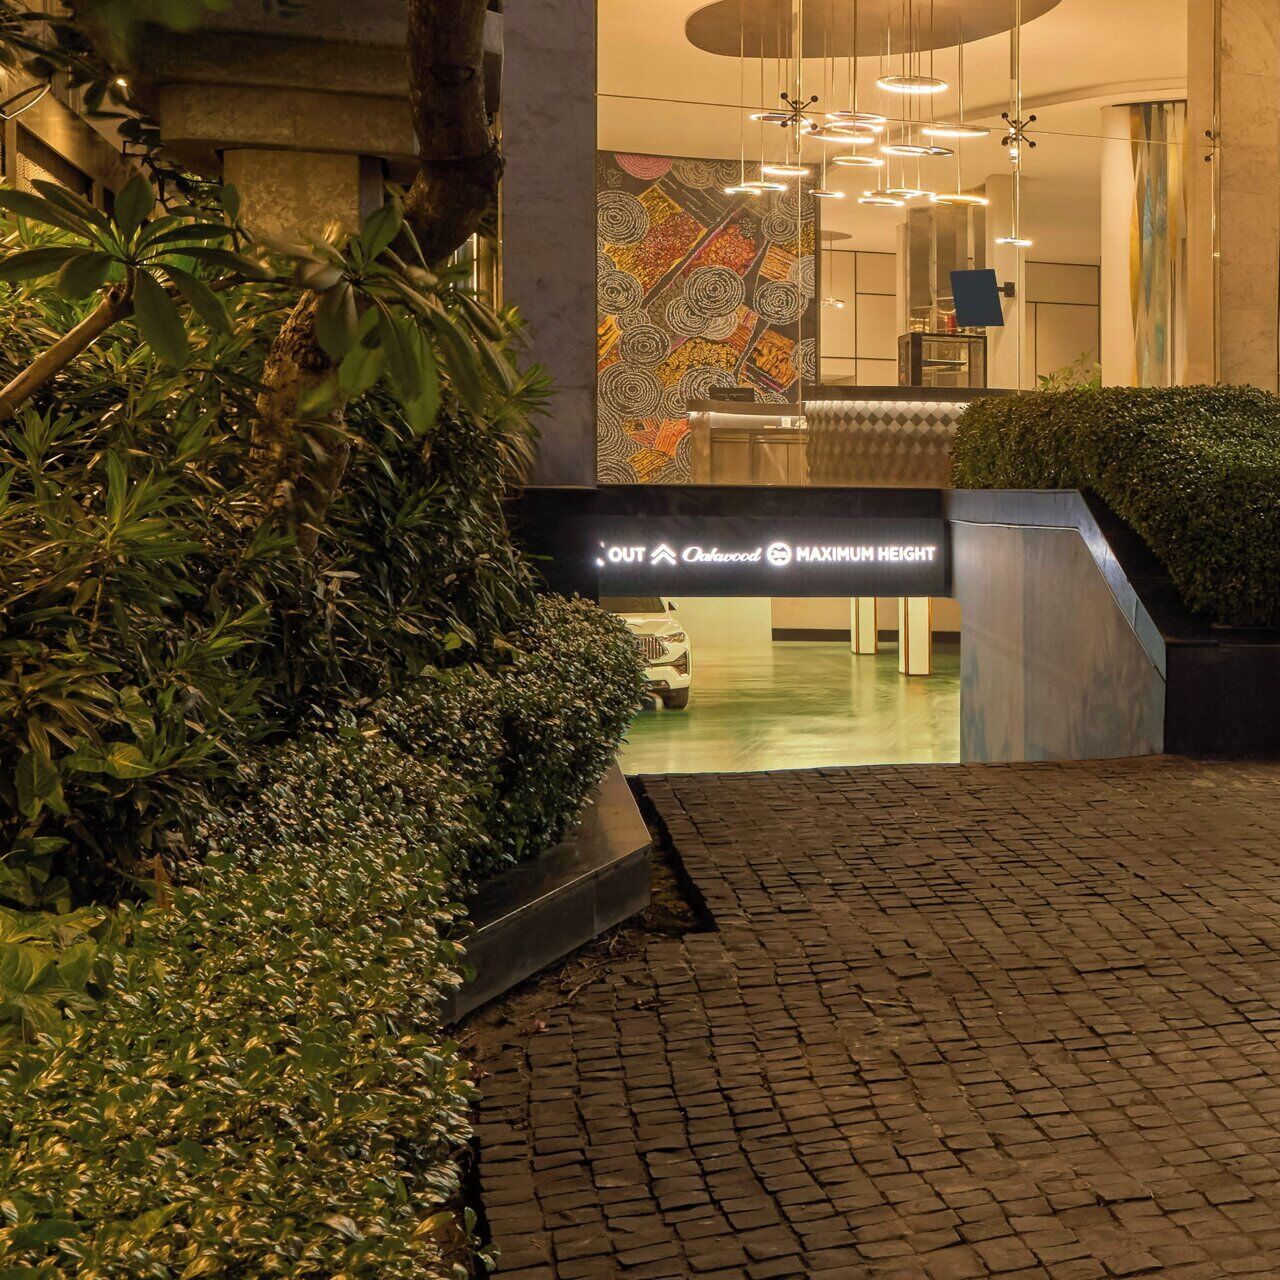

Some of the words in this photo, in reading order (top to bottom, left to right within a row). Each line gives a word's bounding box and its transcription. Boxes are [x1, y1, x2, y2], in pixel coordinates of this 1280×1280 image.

[607, 546, 646, 562] OUT
[682, 546, 762, 563] Oakwood
[796, 546, 874, 562] MAXIMUM
[877, 546, 936, 562] HEIGHT
